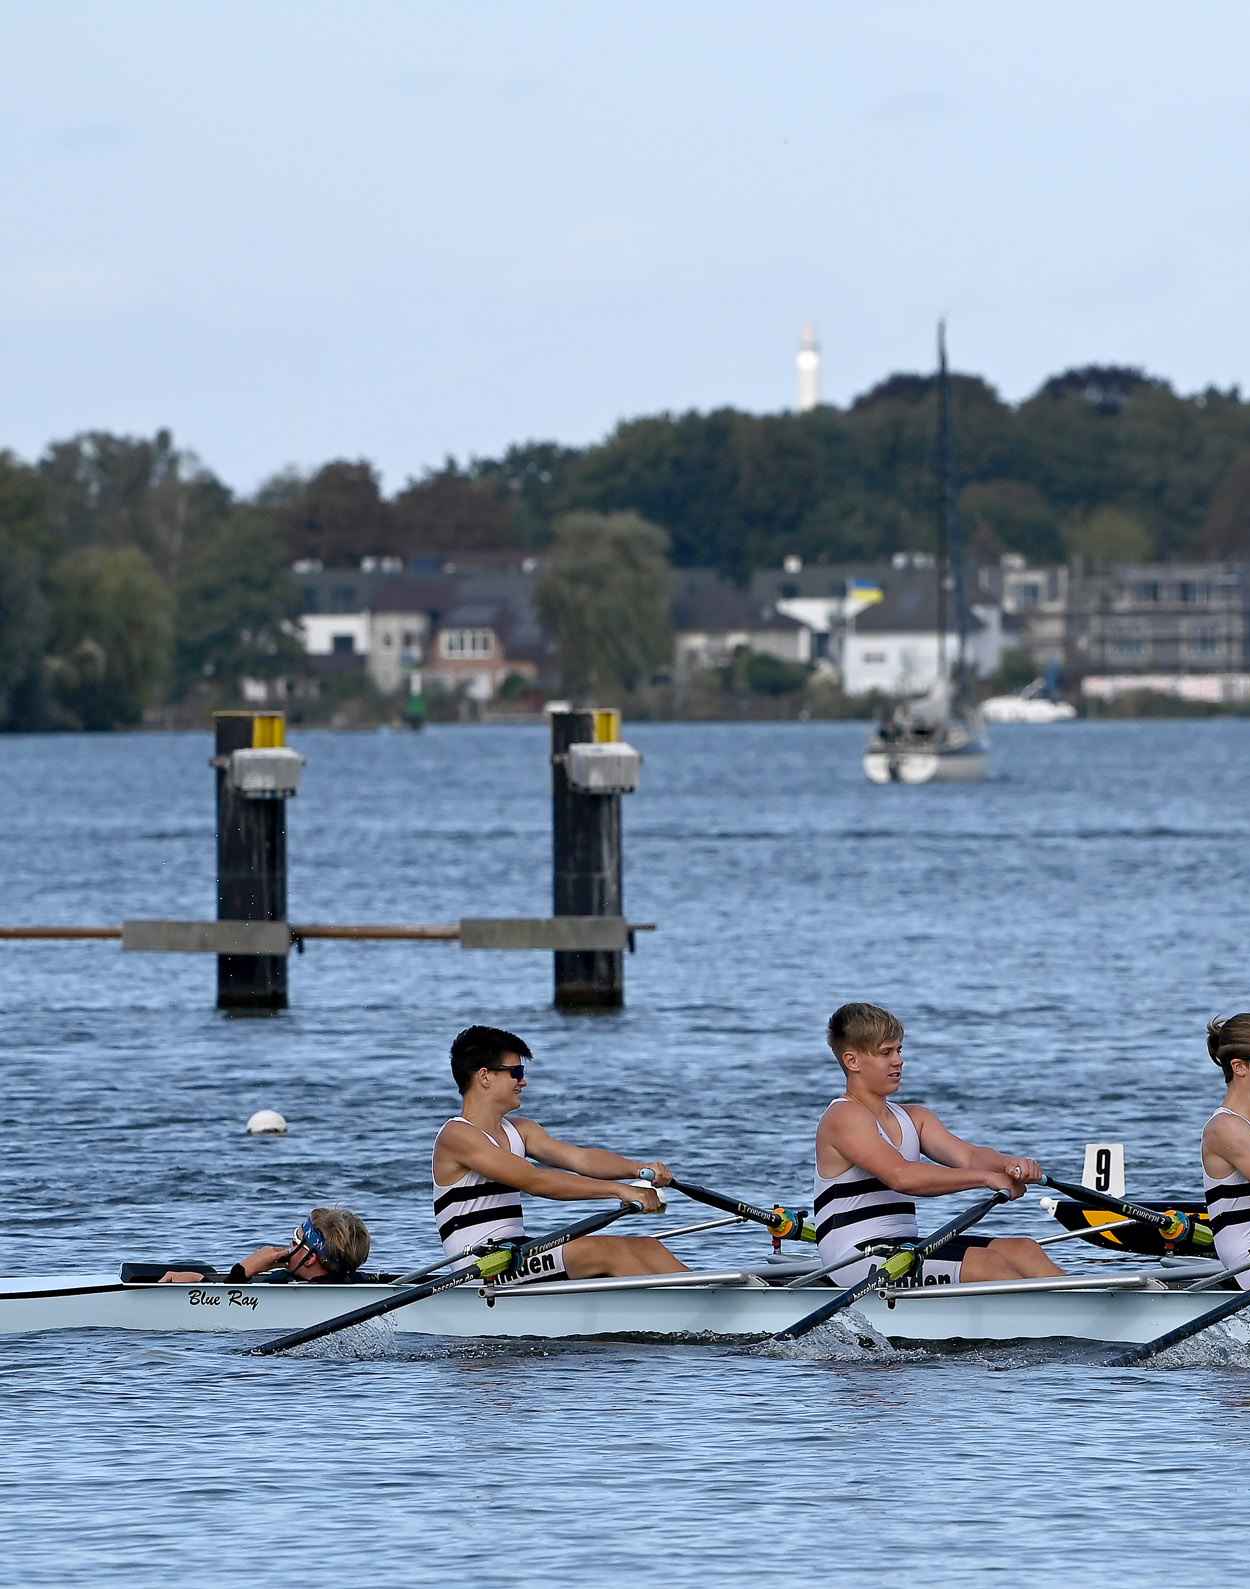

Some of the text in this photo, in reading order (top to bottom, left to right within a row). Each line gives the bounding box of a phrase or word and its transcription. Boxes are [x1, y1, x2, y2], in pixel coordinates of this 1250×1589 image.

[1095, 1148, 1111, 1192] 9
[771, 1215, 777, 1223] 2
[1132, 1208, 1166, 1225] concept 2
[188, 1289, 259, 1311] Blue Ray
